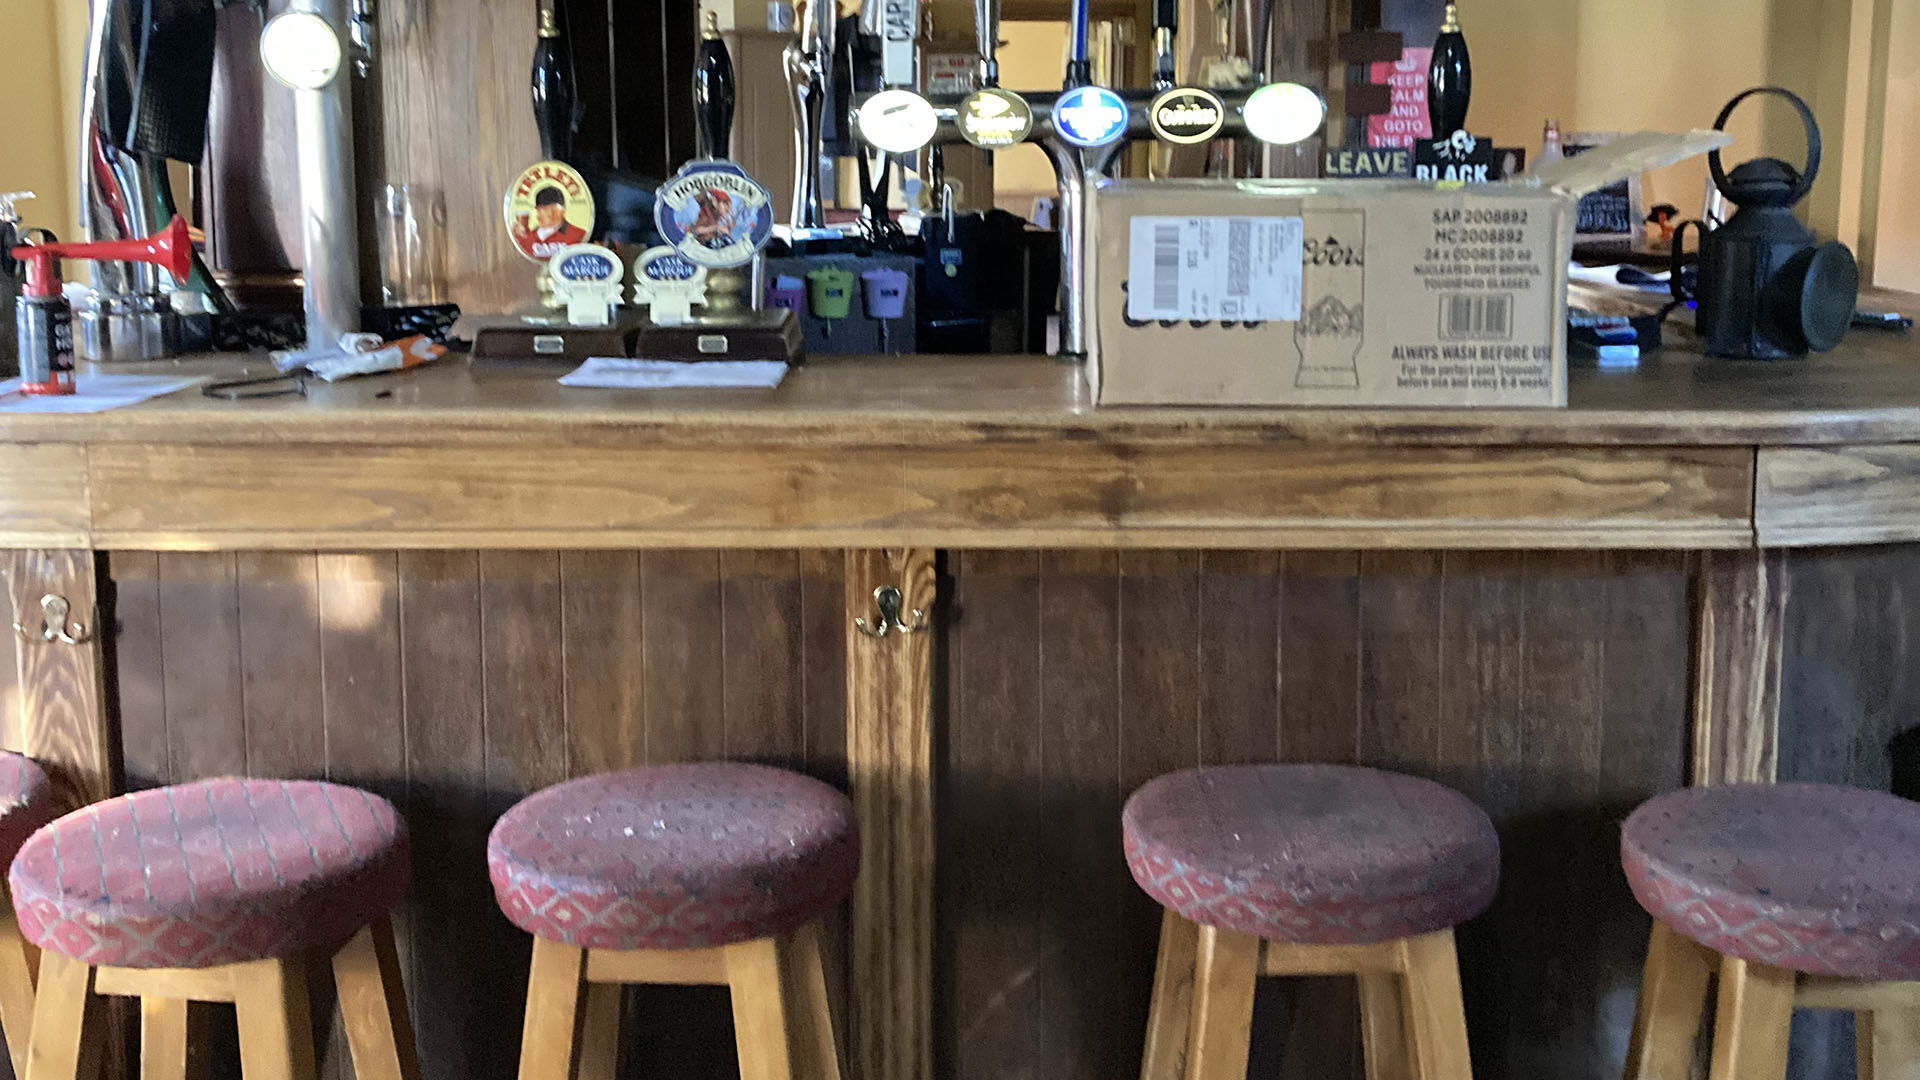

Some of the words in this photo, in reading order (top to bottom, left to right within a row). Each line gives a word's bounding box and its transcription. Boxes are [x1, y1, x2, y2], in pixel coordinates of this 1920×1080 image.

[1388, 74, 1424, 86] KEEP
[1391, 89, 1425, 102] ALM
[1391, 104, 1419, 117] AND
[1325, 151, 1408, 174] LEAVE
[674, 174, 755, 199] HOBGOBLIN
[1432, 208, 1461, 225] SAP
[1391, 345, 1439, 360] ALWAYS
[1442, 345, 1477, 360] WASH
[1480, 344, 1528, 360] BEFORE
